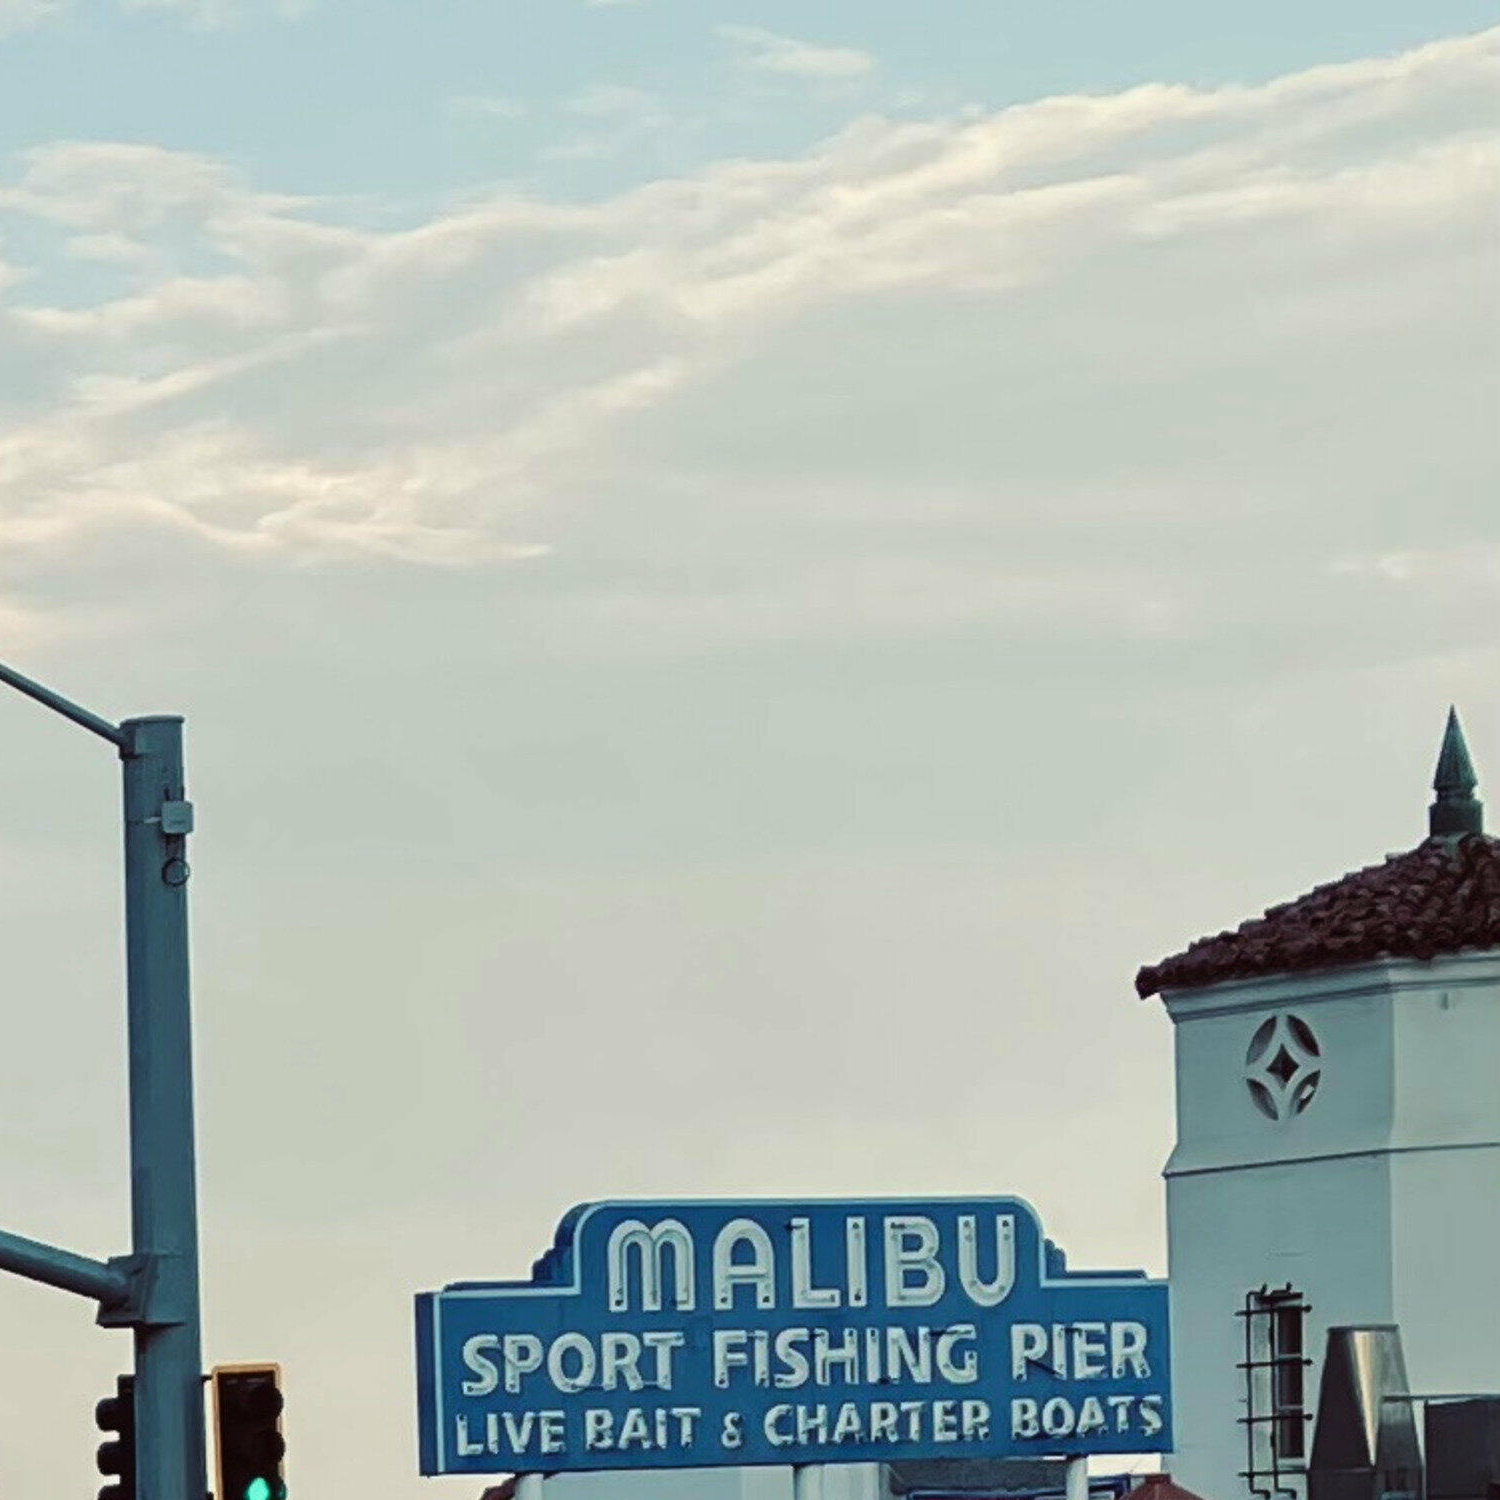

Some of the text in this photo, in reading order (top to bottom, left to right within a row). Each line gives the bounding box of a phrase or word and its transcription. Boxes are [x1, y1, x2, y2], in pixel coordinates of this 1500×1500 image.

[607, 1214, 1016, 1313] MALIBU
[461, 1321, 1152, 1396] SPORT FISHING PIER
[456, 1394, 1164, 1456] LIVE BAIT & CHARTER BOATS
